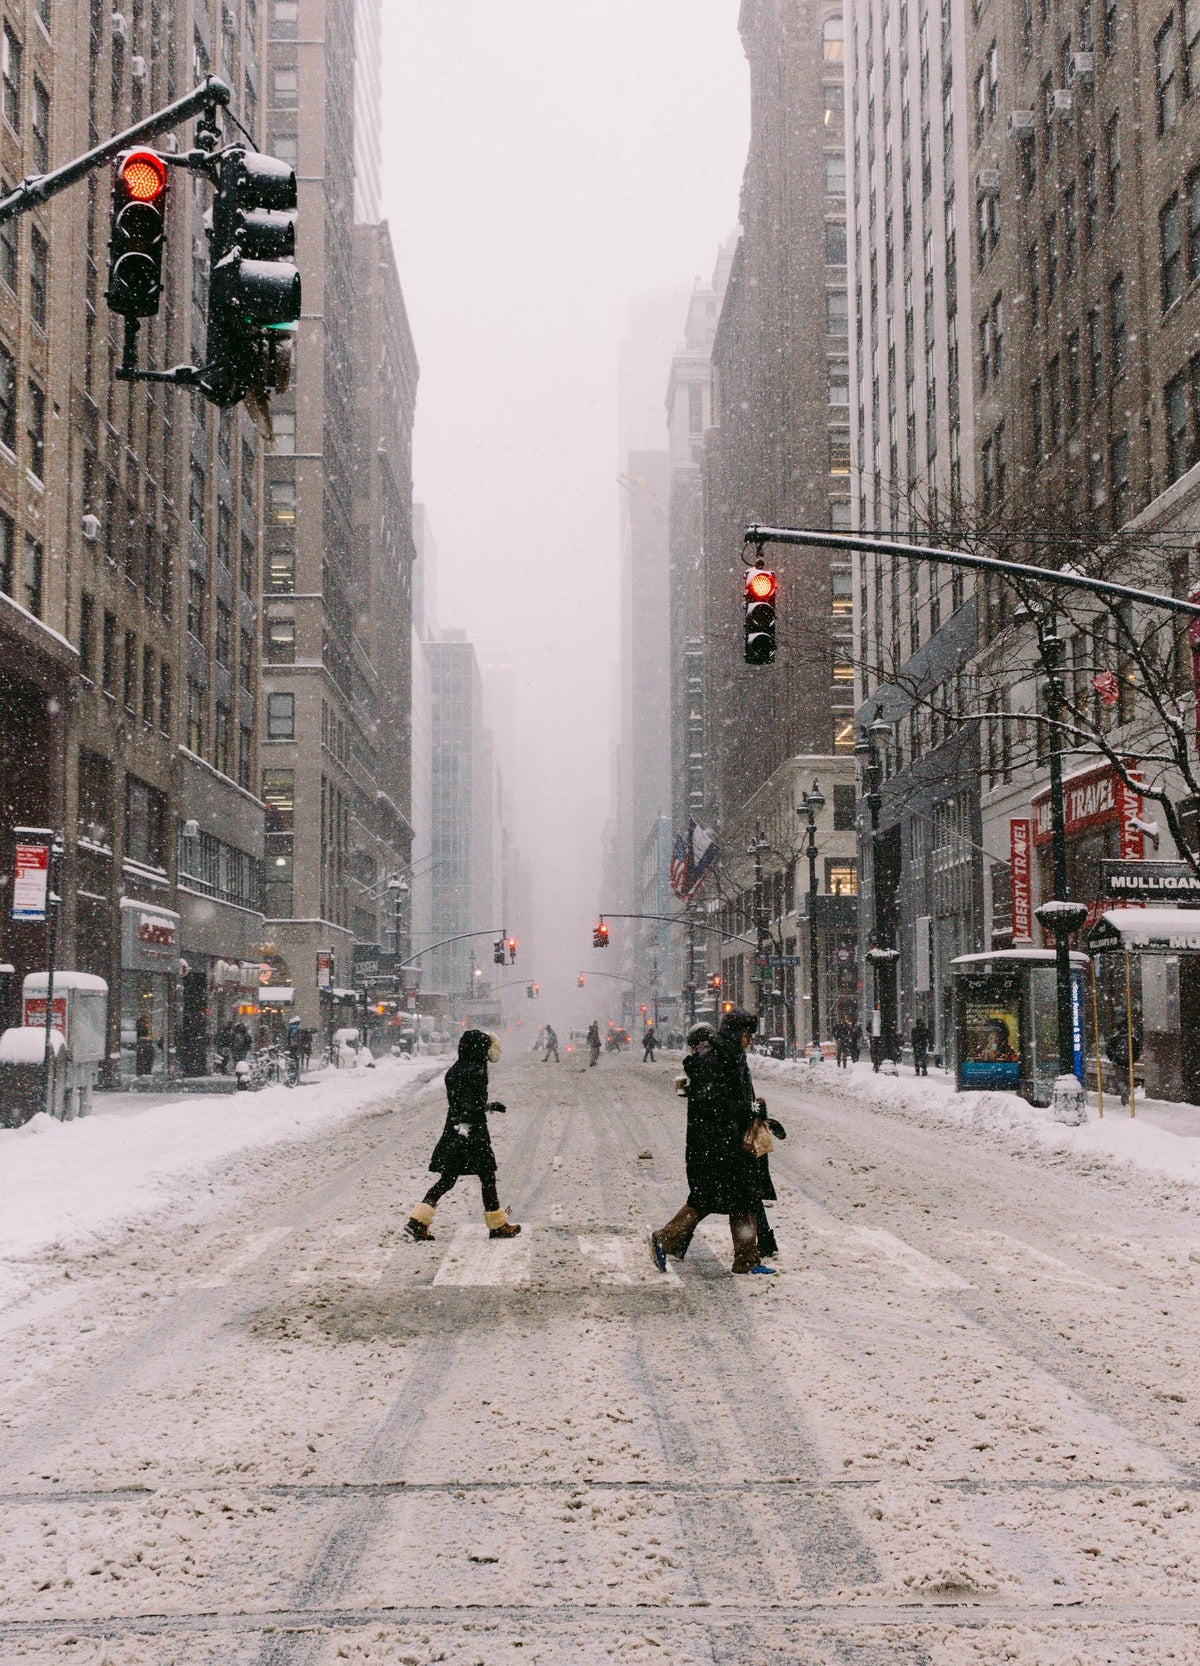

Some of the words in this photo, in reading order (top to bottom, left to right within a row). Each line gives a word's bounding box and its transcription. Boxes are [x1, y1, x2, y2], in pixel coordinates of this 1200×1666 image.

[1071, 779, 1115, 821] TRAVEL
[1013, 823, 1027, 875] TRAVEL
[1111, 876, 1200, 889] MULLIGAN
[1015, 879, 1029, 940] LIBERTY
